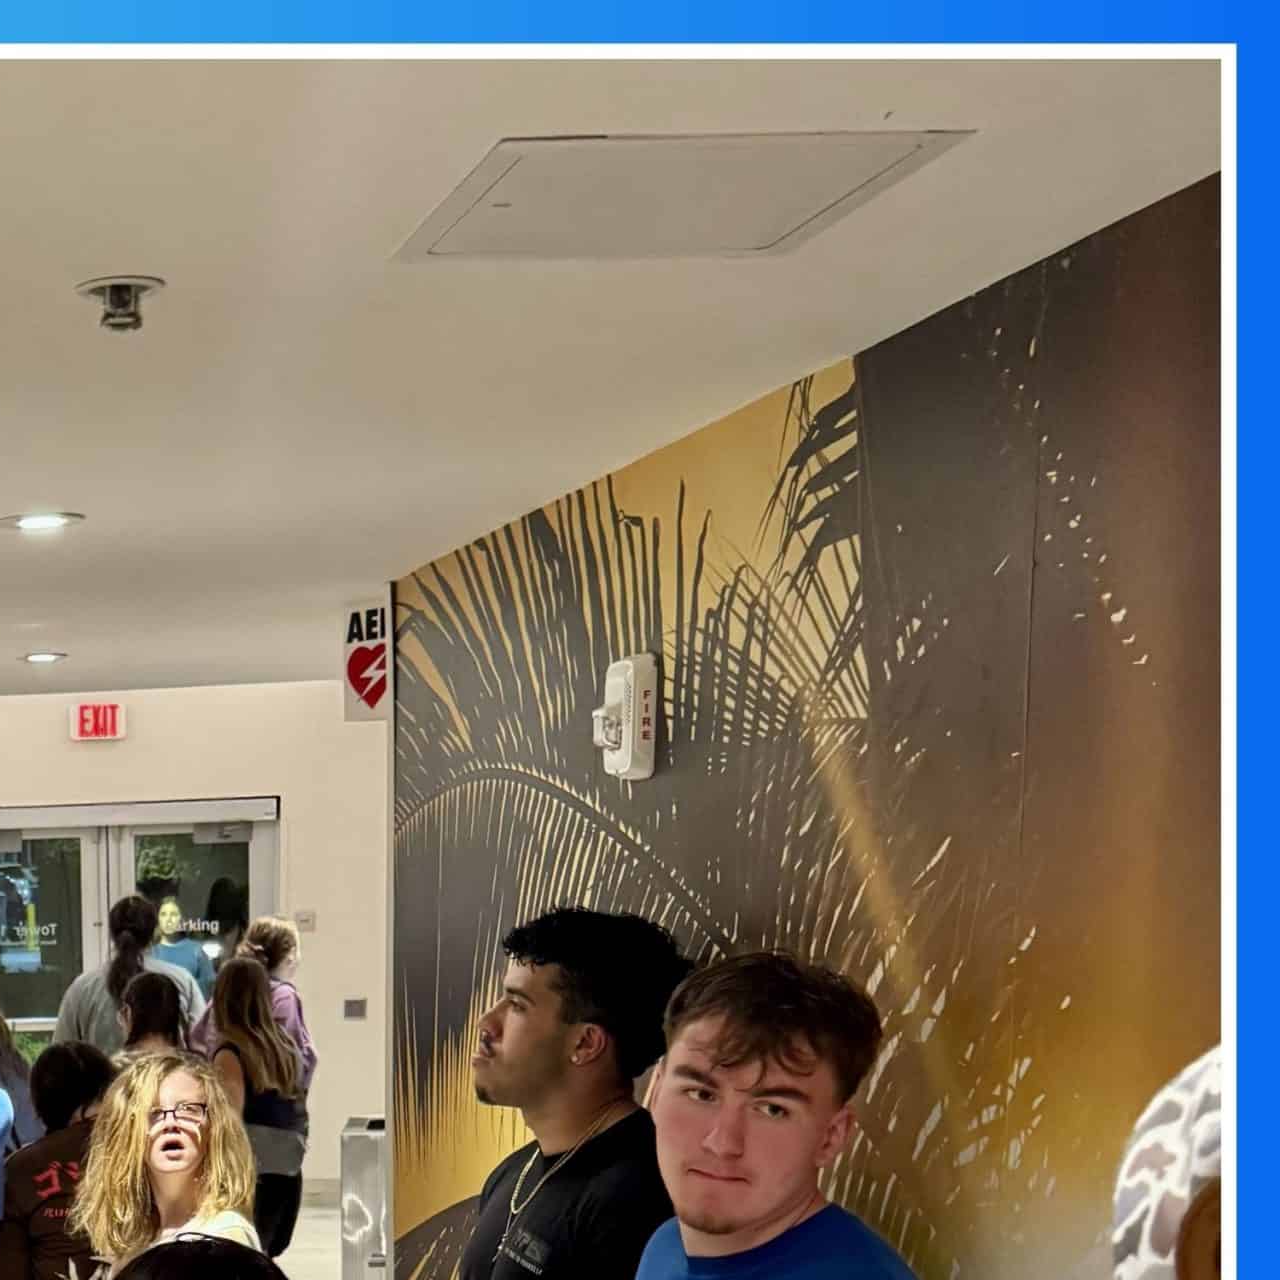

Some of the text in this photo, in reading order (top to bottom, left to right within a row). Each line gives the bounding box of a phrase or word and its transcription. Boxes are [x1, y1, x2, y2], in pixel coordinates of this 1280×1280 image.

[79, 703, 120, 738] EXIT
[641, 688, 652, 741] FIRE
[172, 917, 220, 936] arking
